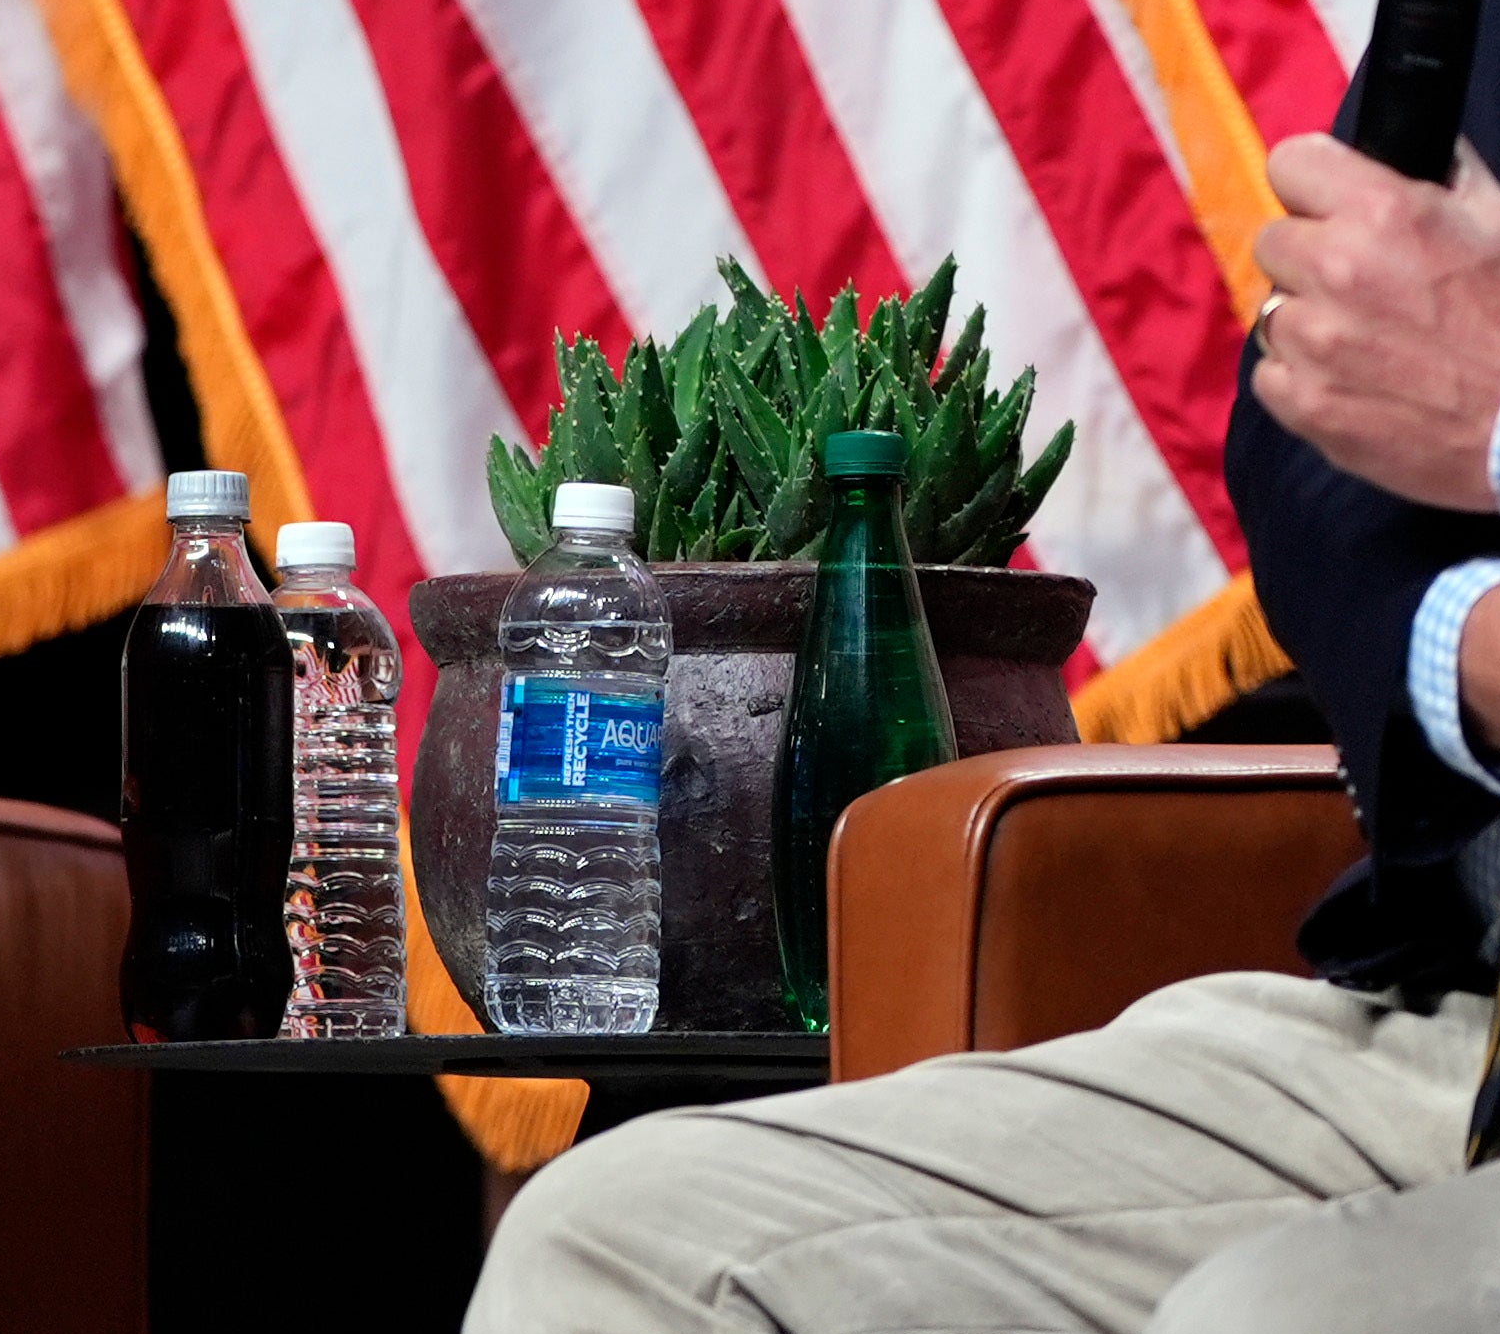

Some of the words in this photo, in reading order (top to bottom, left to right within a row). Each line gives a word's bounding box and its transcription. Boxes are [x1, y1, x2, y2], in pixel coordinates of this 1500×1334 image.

[566, 692, 576, 727] THEN
[563, 728, 574, 786] REFRESH
[572, 692, 590, 786] RECYCLE
